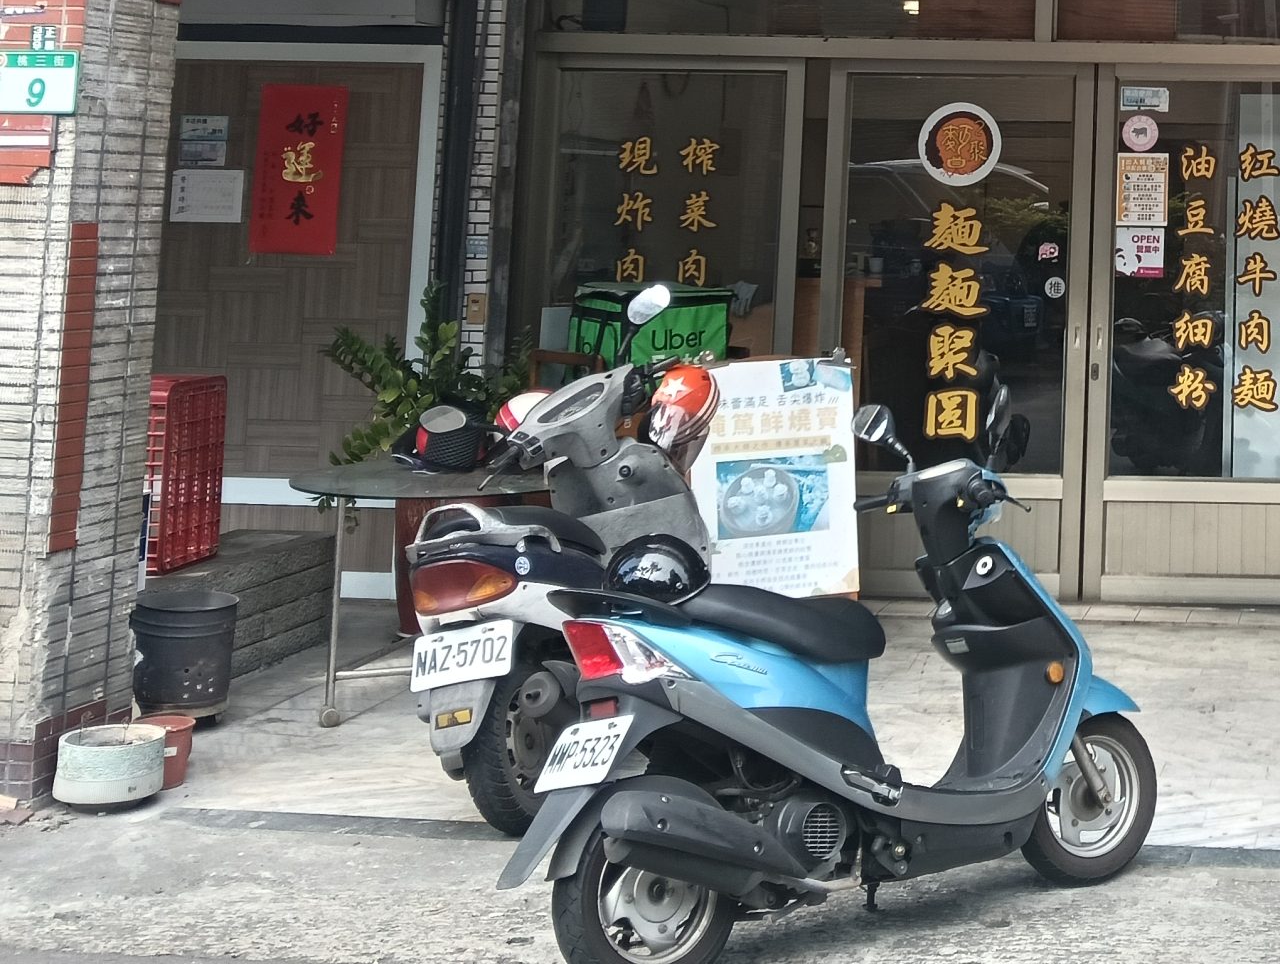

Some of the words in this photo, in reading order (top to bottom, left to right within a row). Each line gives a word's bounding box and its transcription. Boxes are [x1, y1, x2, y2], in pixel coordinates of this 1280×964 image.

[26, 77, 46, 108] 9
[1131, 234, 1161, 244] OPEN
[1169, 146, 1217, 411] 油豆腐細粉
[1233, 144, 1280, 412] 紅燒牛肉麵
[651, 329, 706, 351] Uber
